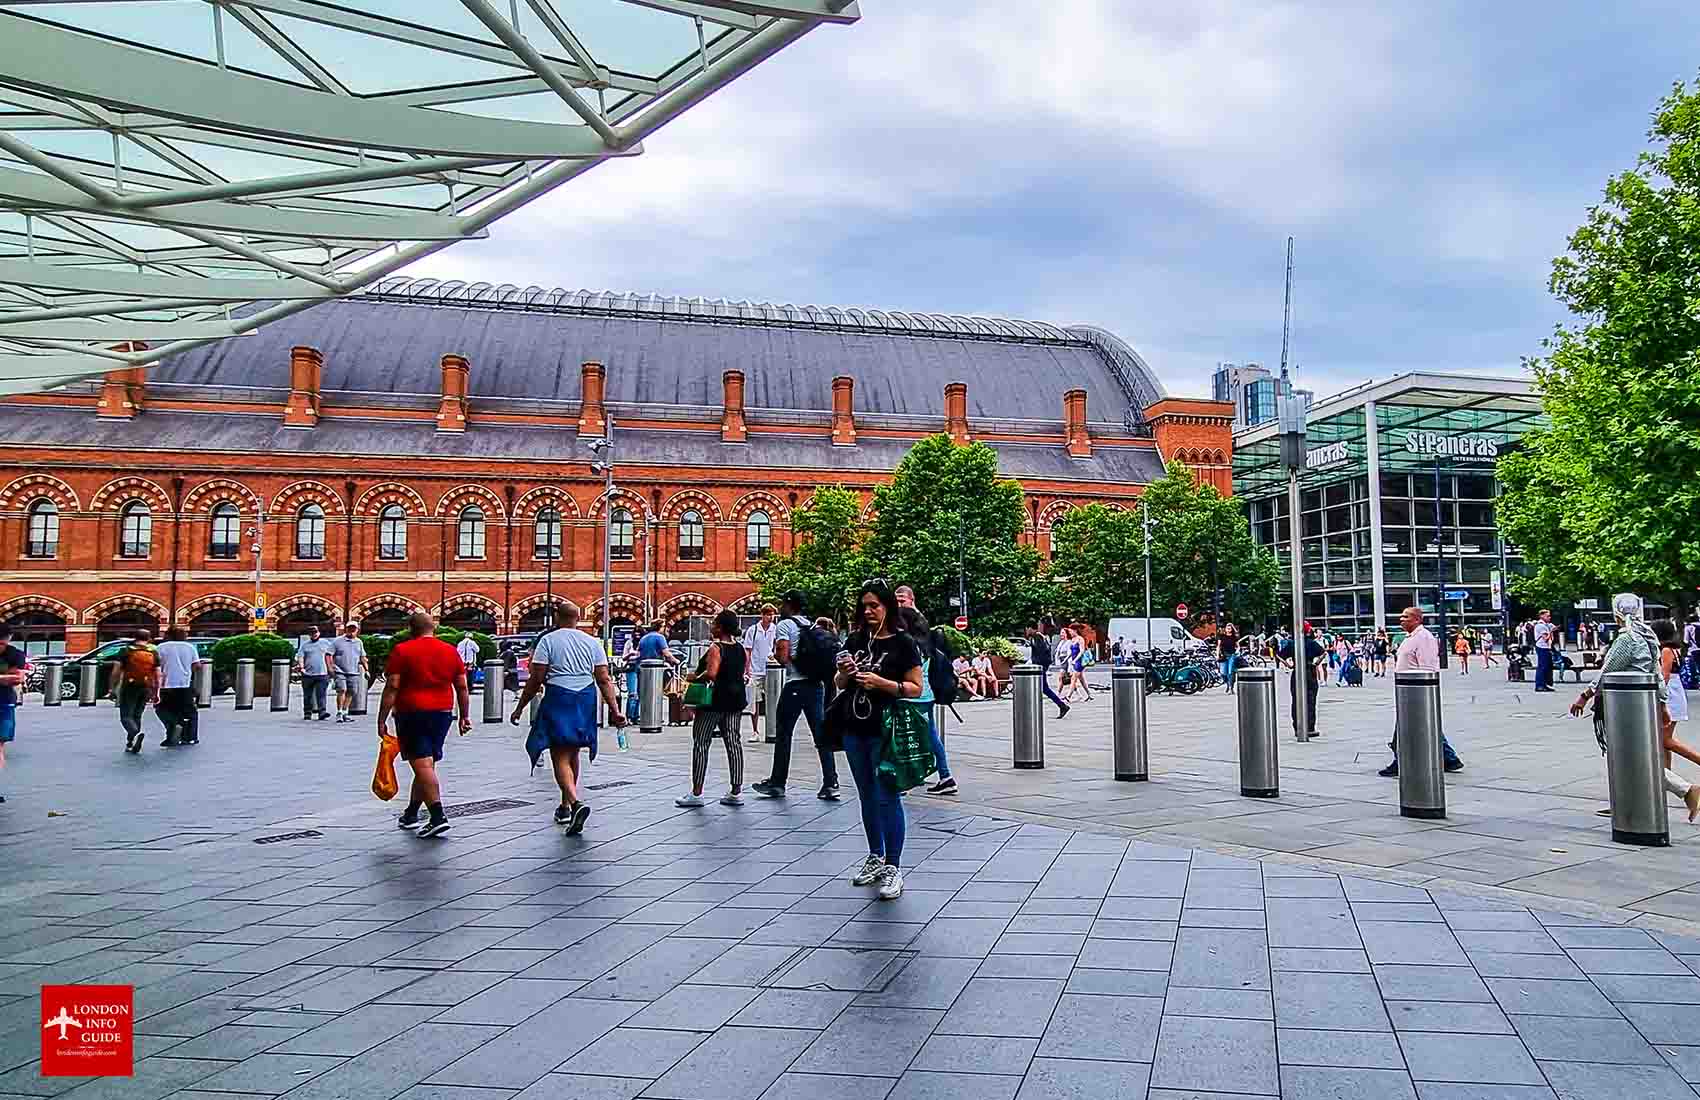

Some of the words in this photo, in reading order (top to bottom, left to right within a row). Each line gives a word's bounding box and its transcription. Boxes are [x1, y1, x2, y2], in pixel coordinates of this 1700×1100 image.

[1306, 441, 1348, 468] ancras
[1406, 432, 1425, 453] St
[1425, 432, 1498, 456] Pancras
